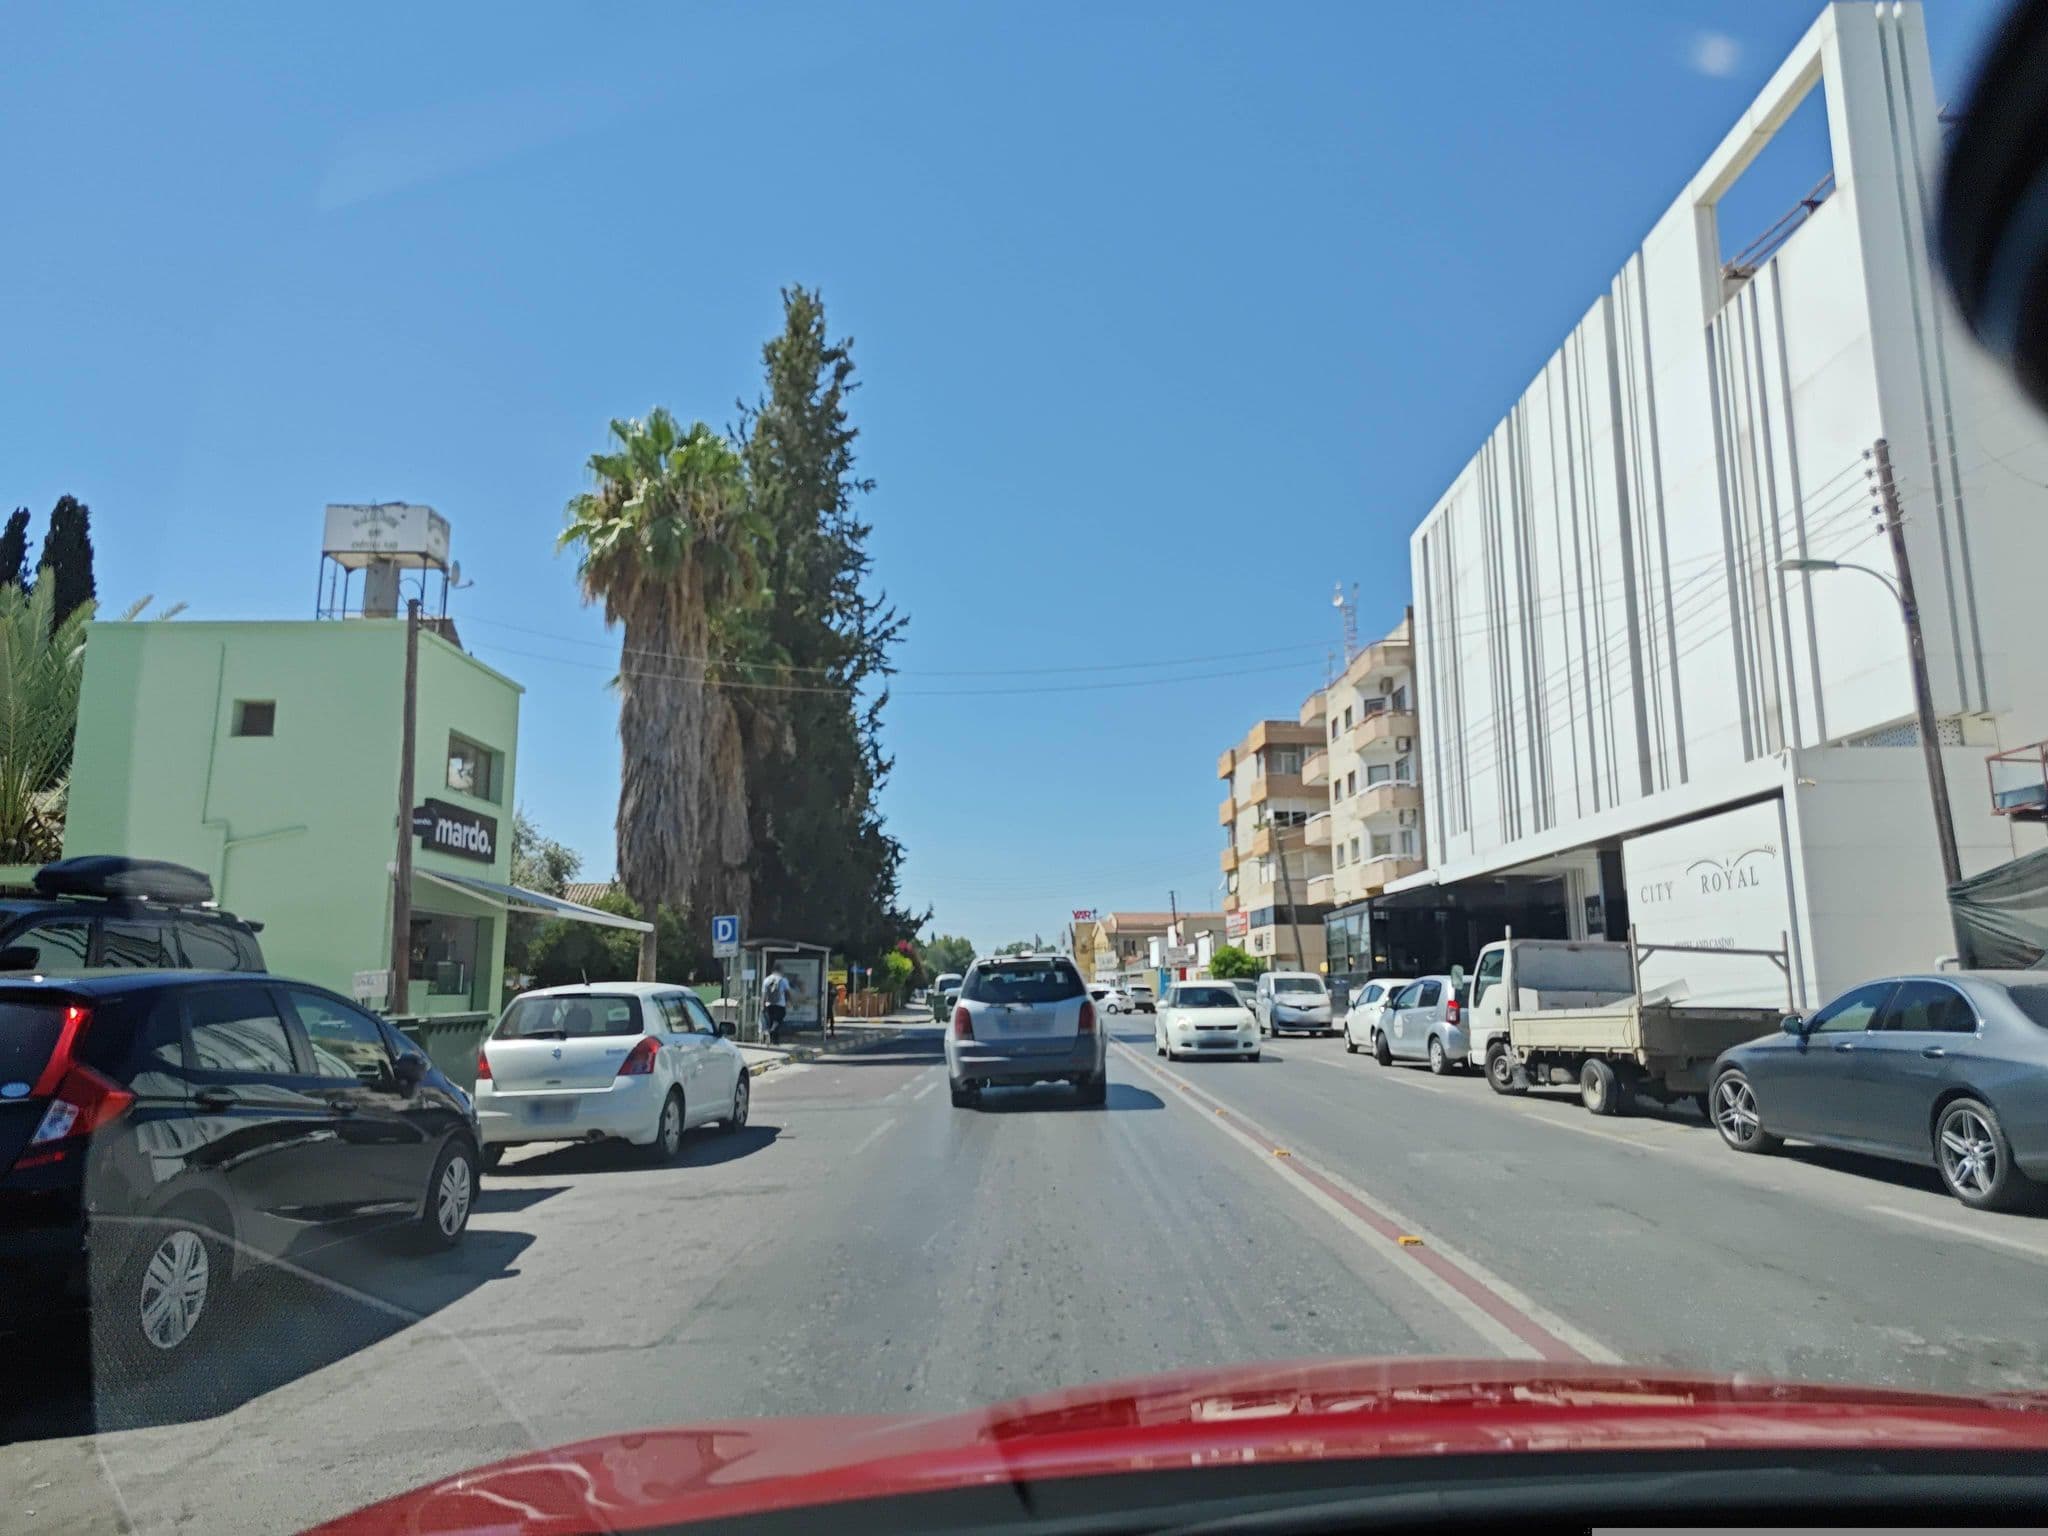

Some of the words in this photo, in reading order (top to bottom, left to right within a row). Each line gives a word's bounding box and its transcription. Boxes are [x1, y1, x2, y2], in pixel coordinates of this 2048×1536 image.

[435, 818, 492, 855] mardo.
[1640, 881, 1673, 904] CITY
[1701, 865, 1760, 895] ROYAL
[718, 920, 733, 942] D
